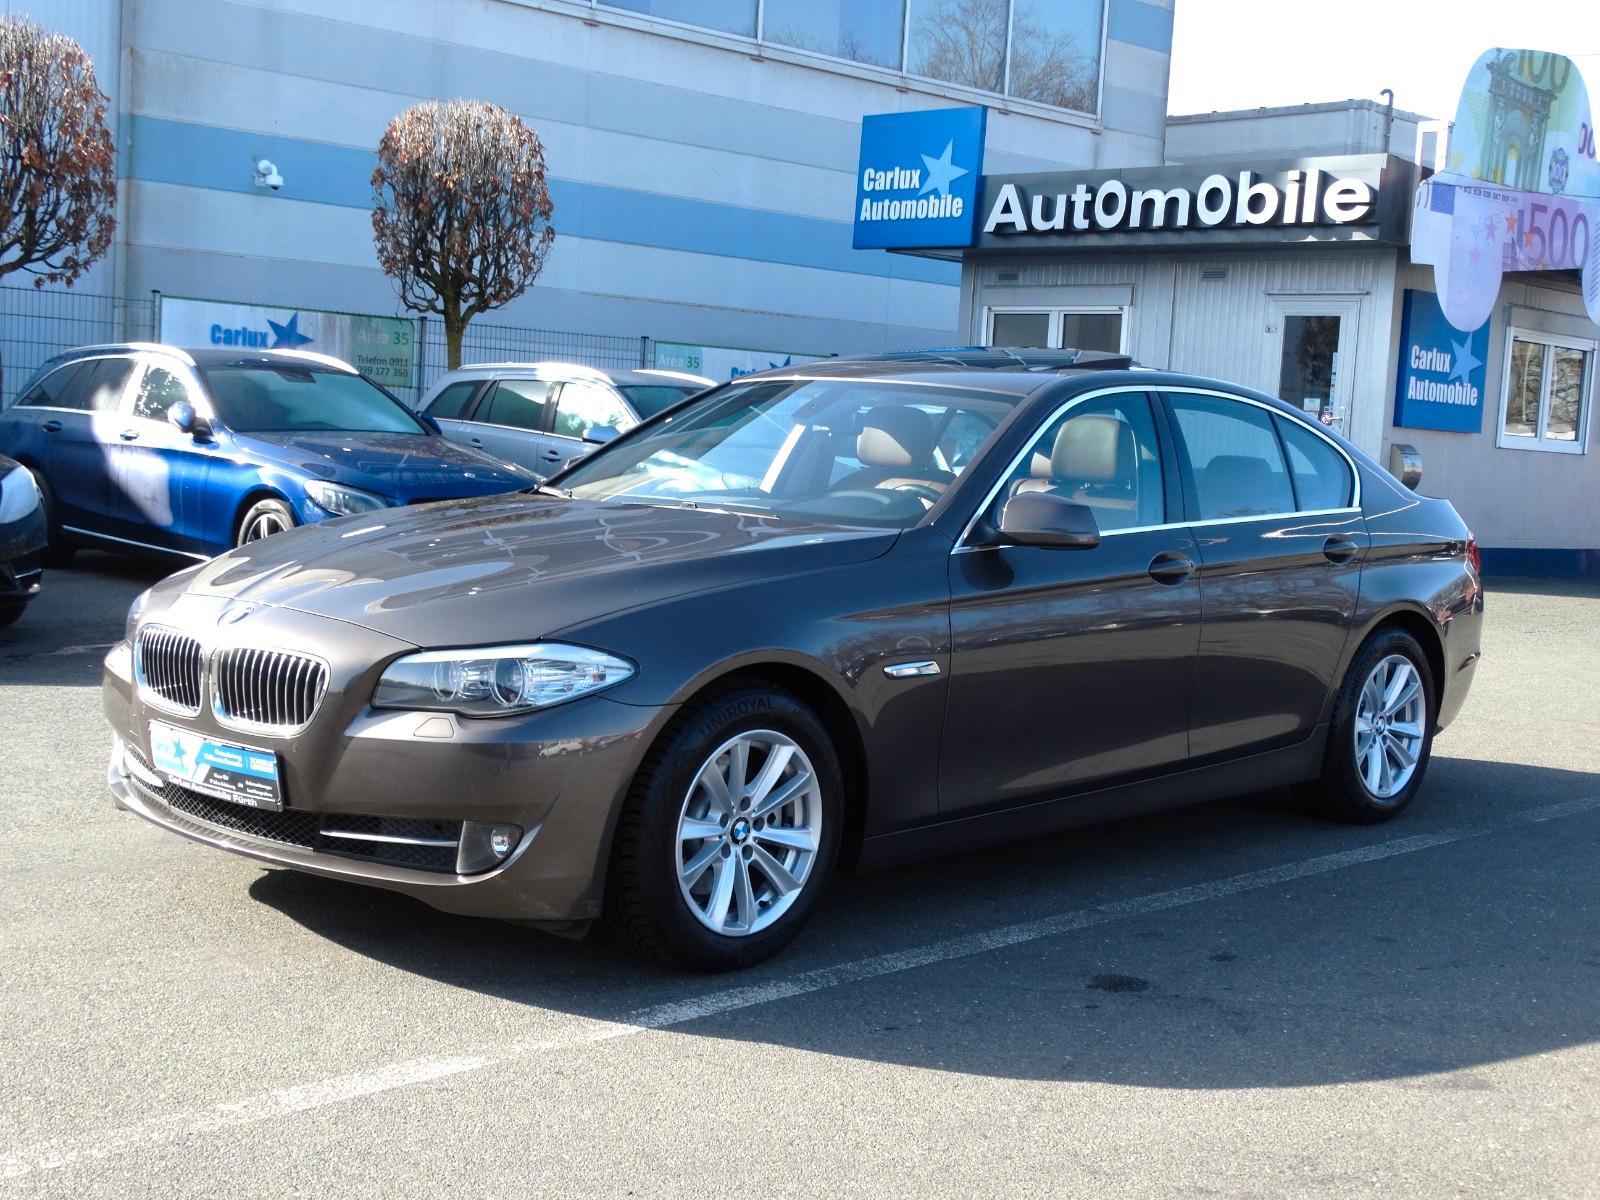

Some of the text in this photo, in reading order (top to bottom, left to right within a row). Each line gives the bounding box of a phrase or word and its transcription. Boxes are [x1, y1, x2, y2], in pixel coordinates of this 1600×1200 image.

[863, 166, 921, 192] Carlux
[859, 193, 963, 221] Automobile
[1528, 203, 1590, 269] 500
[210, 323, 269, 349] Carlux
[393, 331, 409, 346] 35
[357, 355, 408, 368] Telefon 0911
[658, 354, 700, 369] Area 35
[1411, 344, 1452, 373] Carlux
[376, 367, 390, 377] 177
[393, 368, 409, 378] 350
[1407, 375, 1478, 407] Automobile
[698, 695, 777, 738] UNIROYAL
